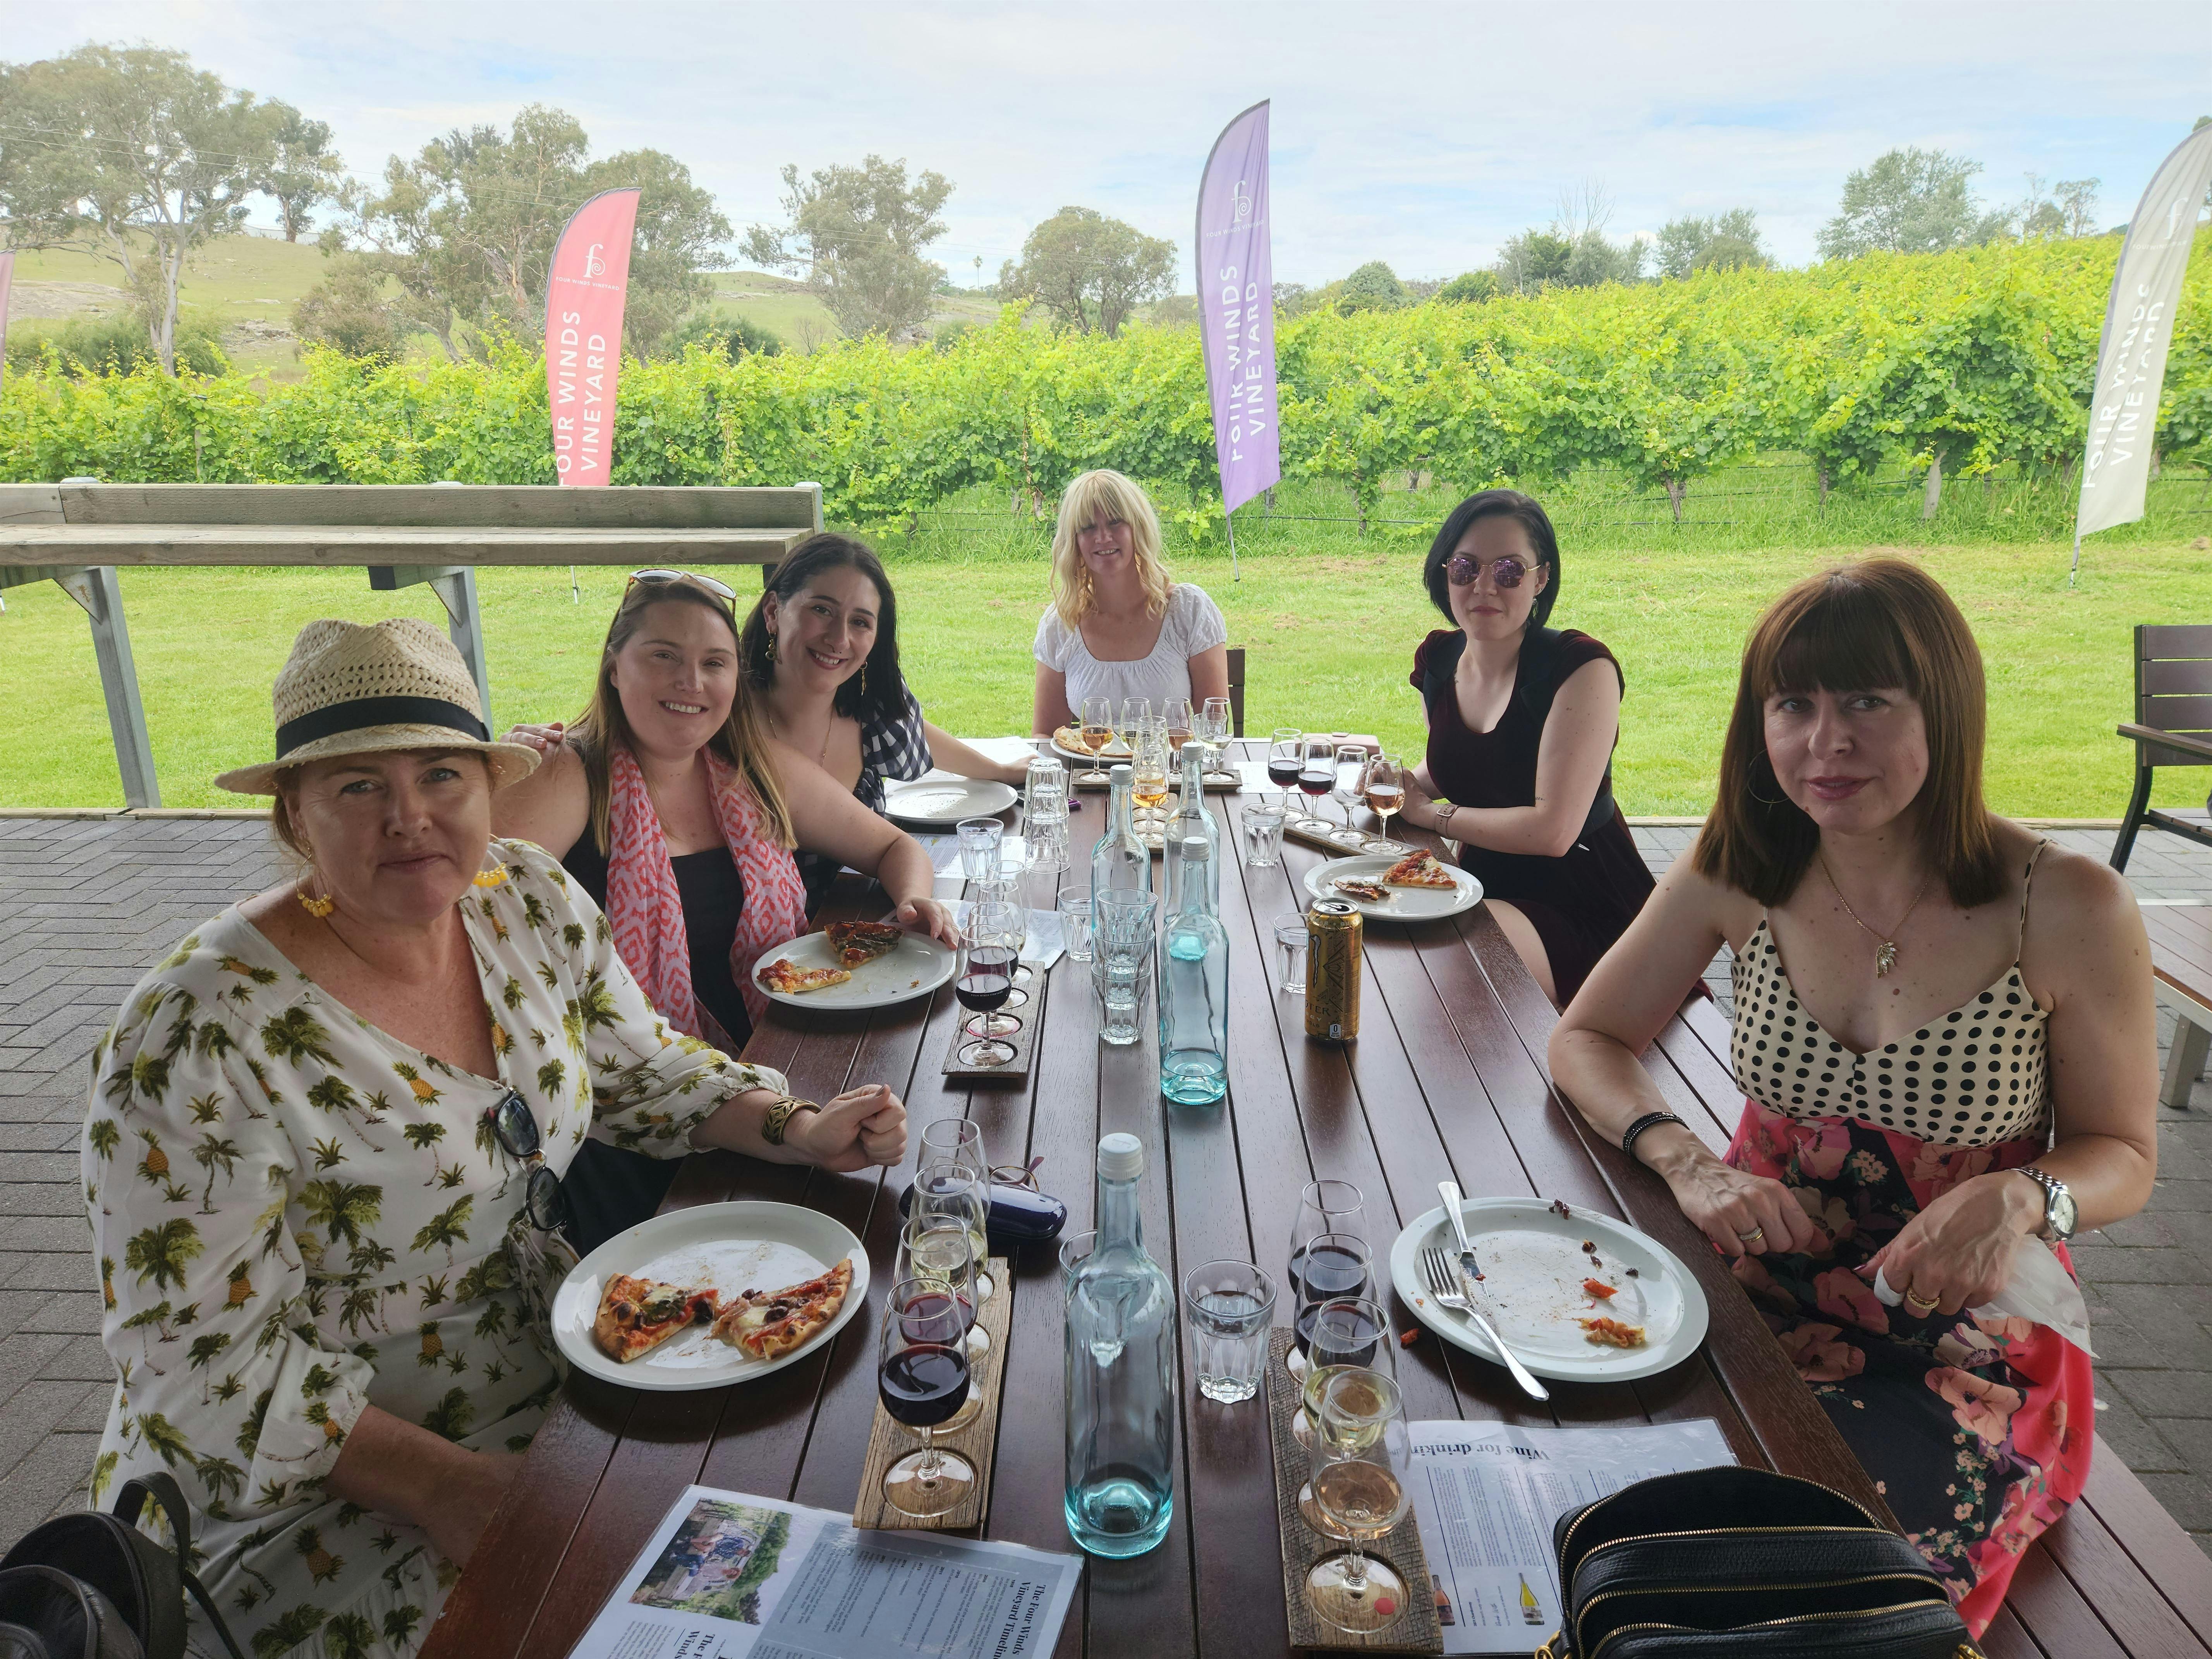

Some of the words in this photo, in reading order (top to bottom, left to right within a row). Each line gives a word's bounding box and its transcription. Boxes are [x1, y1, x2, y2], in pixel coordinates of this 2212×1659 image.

[1223, 226, 1240, 234] WINDS
[592, 282, 620, 290] VINEYARD
[1220, 266, 1241, 371] WINDS
[558, 311, 580, 404] WINDS
[1245, 282, 1266, 436] VINEYARD
[581, 334, 606, 471] VINEYARD
[1411, 1444, 1472, 1456] drinkin
[1477, 1444, 1502, 1455] for
[1506, 1446, 1551, 1460] Wine
[1008, 1582, 1031, 1621] Vineyard
[1033, 1585, 1046, 1600] The
[1025, 1602, 1039, 1623] Four
[674, 1631, 700, 1659] Winds
[698, 1634, 716, 1652] The
[993, 1623, 1015, 1659] Timelin
[1013, 1626, 1031, 1655] Winds
